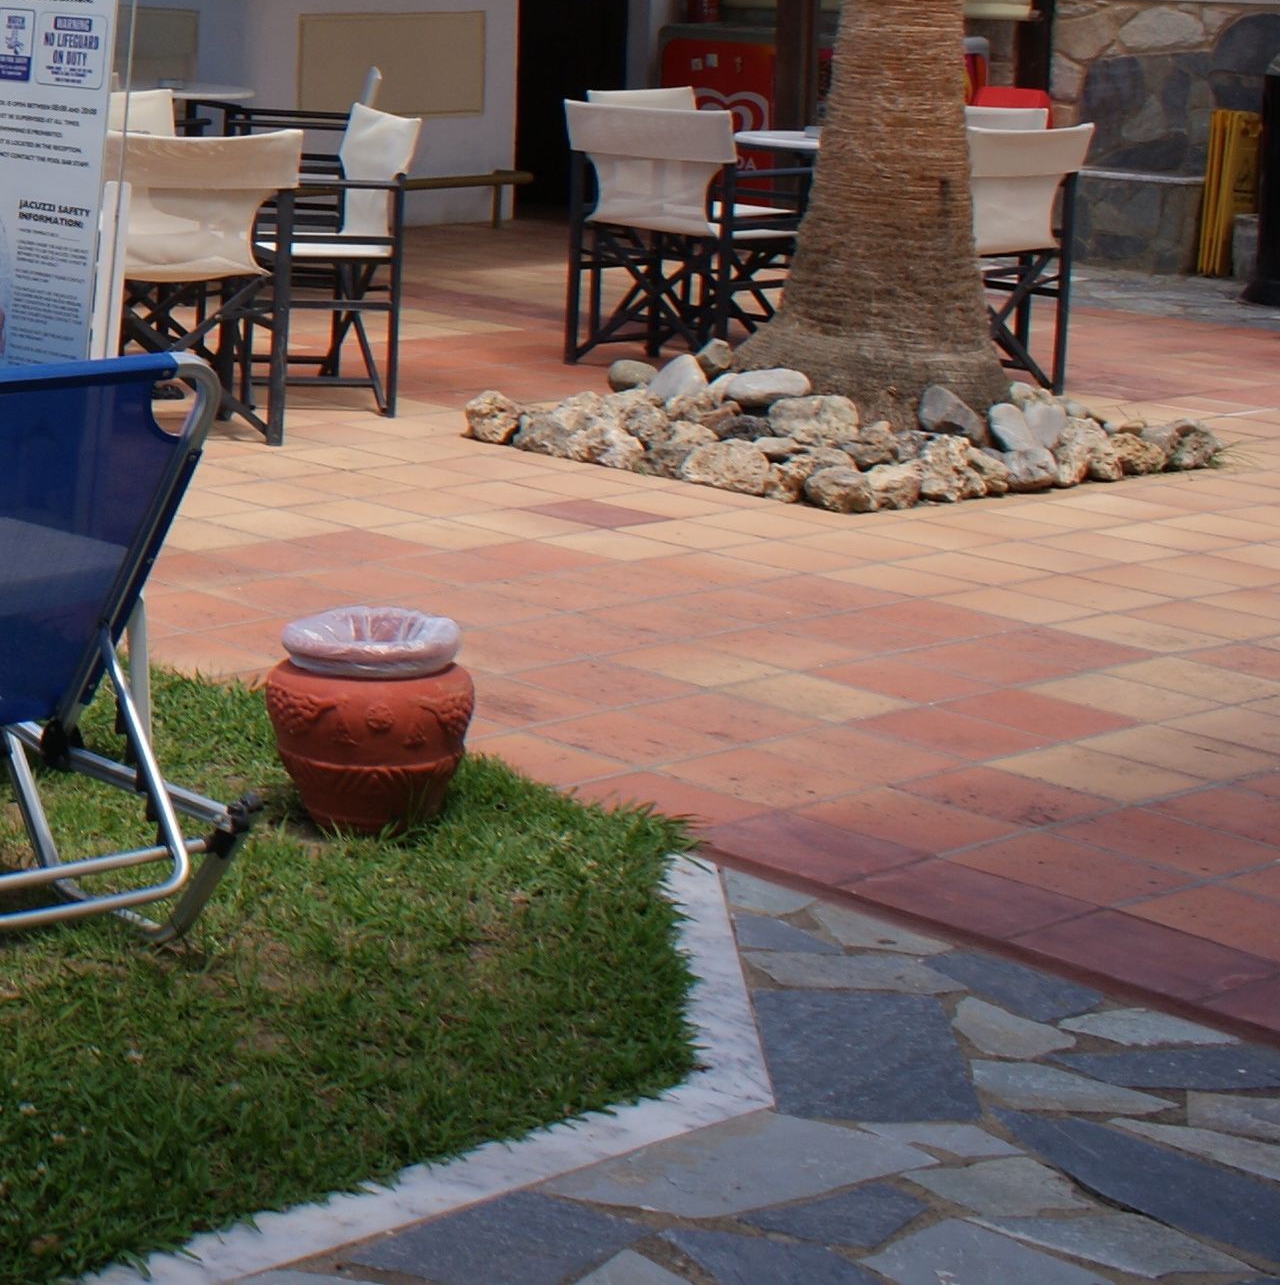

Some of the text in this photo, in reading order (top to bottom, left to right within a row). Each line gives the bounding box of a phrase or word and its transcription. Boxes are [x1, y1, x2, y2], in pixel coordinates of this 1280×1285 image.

[44, 33, 99, 50] NO LIFEGUARD
[53, 50, 88, 67] ON DUTY
[19, 199, 91, 217] JACUZZI SAFETY
